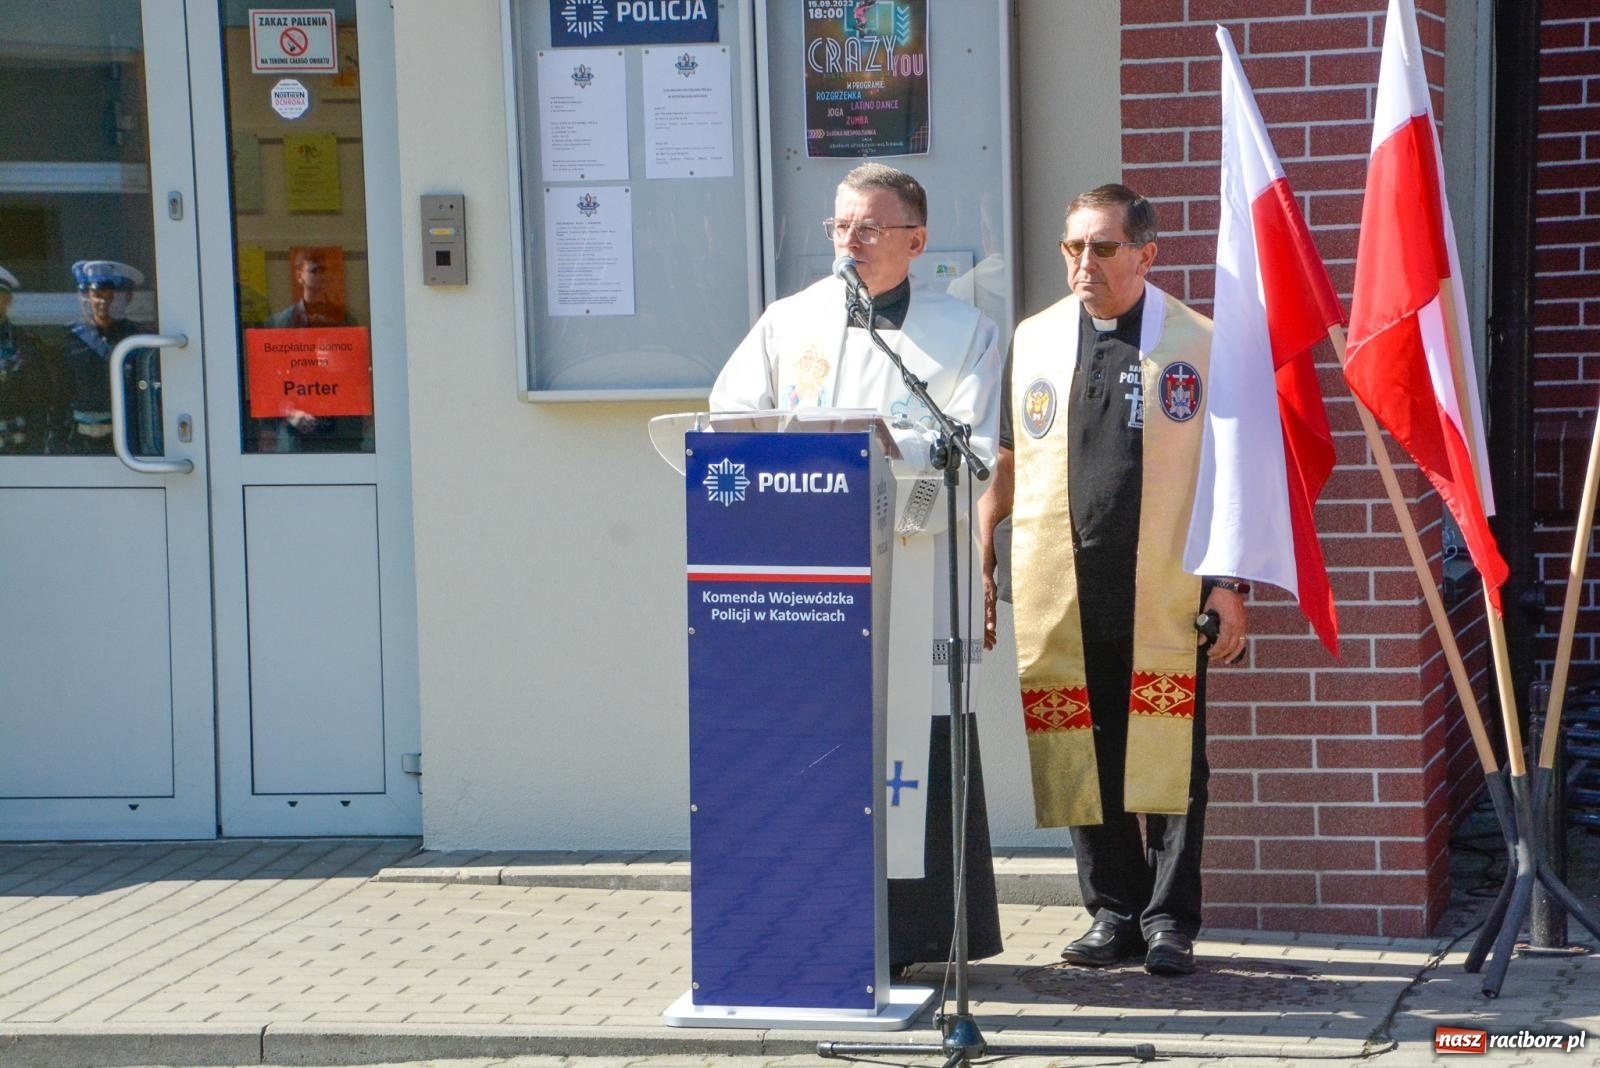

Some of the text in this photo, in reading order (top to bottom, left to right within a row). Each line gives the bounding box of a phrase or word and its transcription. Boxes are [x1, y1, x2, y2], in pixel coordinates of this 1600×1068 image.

[617, 0, 708, 22] POLICJA
[808, 8, 844, 19] 18:00
[258, 17, 328, 26] ZAKAZ PALENIA
[808, 35, 897, 73] CRAZY
[893, 53, 924, 77] YOU
[816, 91, 862, 101] ROZGRZEWKA
[850, 100, 899, 110] LATINO DANCE
[827, 108, 844, 117] JOGA
[846, 115, 869, 125] ZUMBA
[264, 343, 316, 353] Bezpłatna
[283, 381, 339, 396] Parter
[758, 472, 850, 494] POLICJA
[702, 591, 854, 606] Komenda Wojewódzka
[711, 608, 846, 623] Policji w Katowicach
